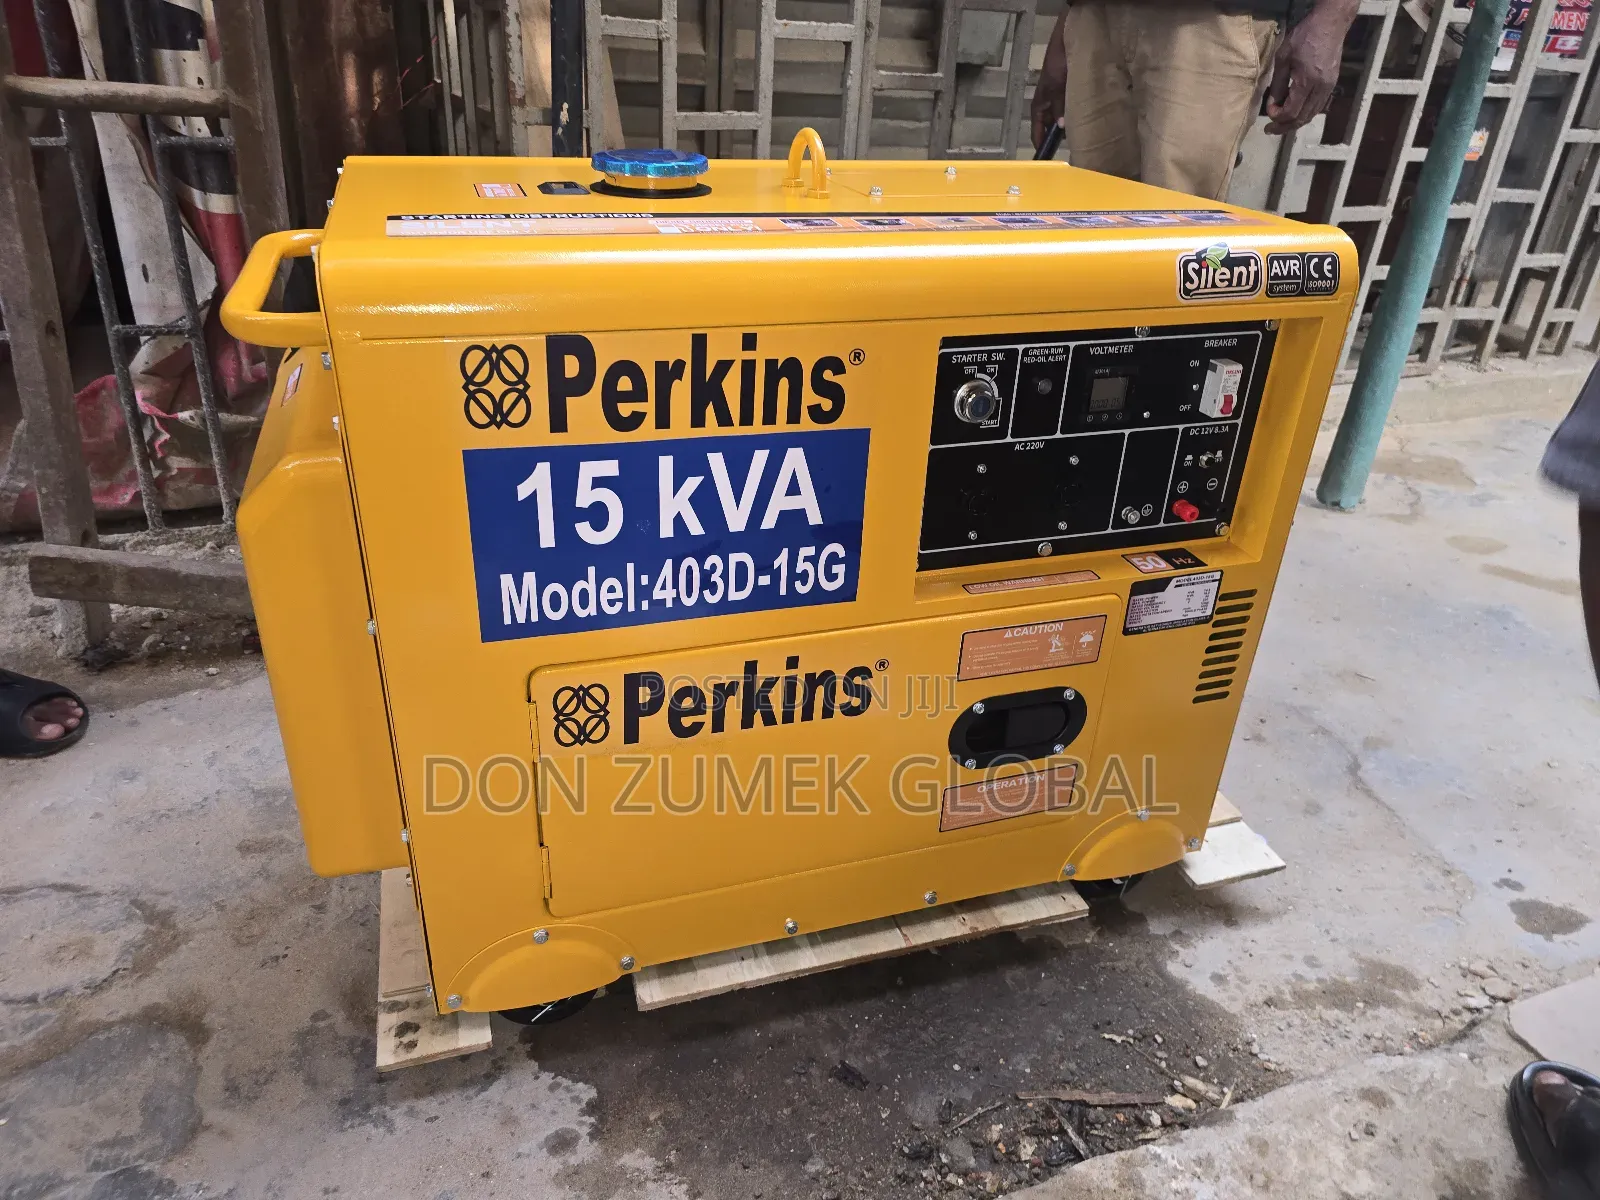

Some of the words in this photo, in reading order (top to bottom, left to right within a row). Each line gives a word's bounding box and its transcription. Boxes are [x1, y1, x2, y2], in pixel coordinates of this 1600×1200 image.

[1550, 11, 1590, 31] MEN
[1185, 258, 1258, 290] Silent
[1271, 260, 1300, 277] AVR
[1309, 257, 1333, 279] CE
[1272, 283, 1297, 292] system
[1089, 345, 1134, 355] VOLTMETER
[1204, 338, 1238, 348] BREAKER
[951, 353, 988, 364] STARTER
[991, 352, 1006, 361] SW.
[545, 332, 847, 433] Perkins
[1189, 428, 1200, 436] DC
[1200, 426, 1214, 435] 12V
[1014, 442, 1025, 451] AC
[1026, 441, 1045, 450] 220V
[516, 459, 625, 549] 15
[658, 446, 824, 539] kVA
[1131, 556, 1167, 570] 50
[1171, 557, 1196, 565] Hz
[500, 542, 847, 626] Model:403D-15G
[1013, 622, 1064, 637] CAUTION
[622, 657, 873, 745] Perkins
[977, 774, 1045, 793] OPERATION
